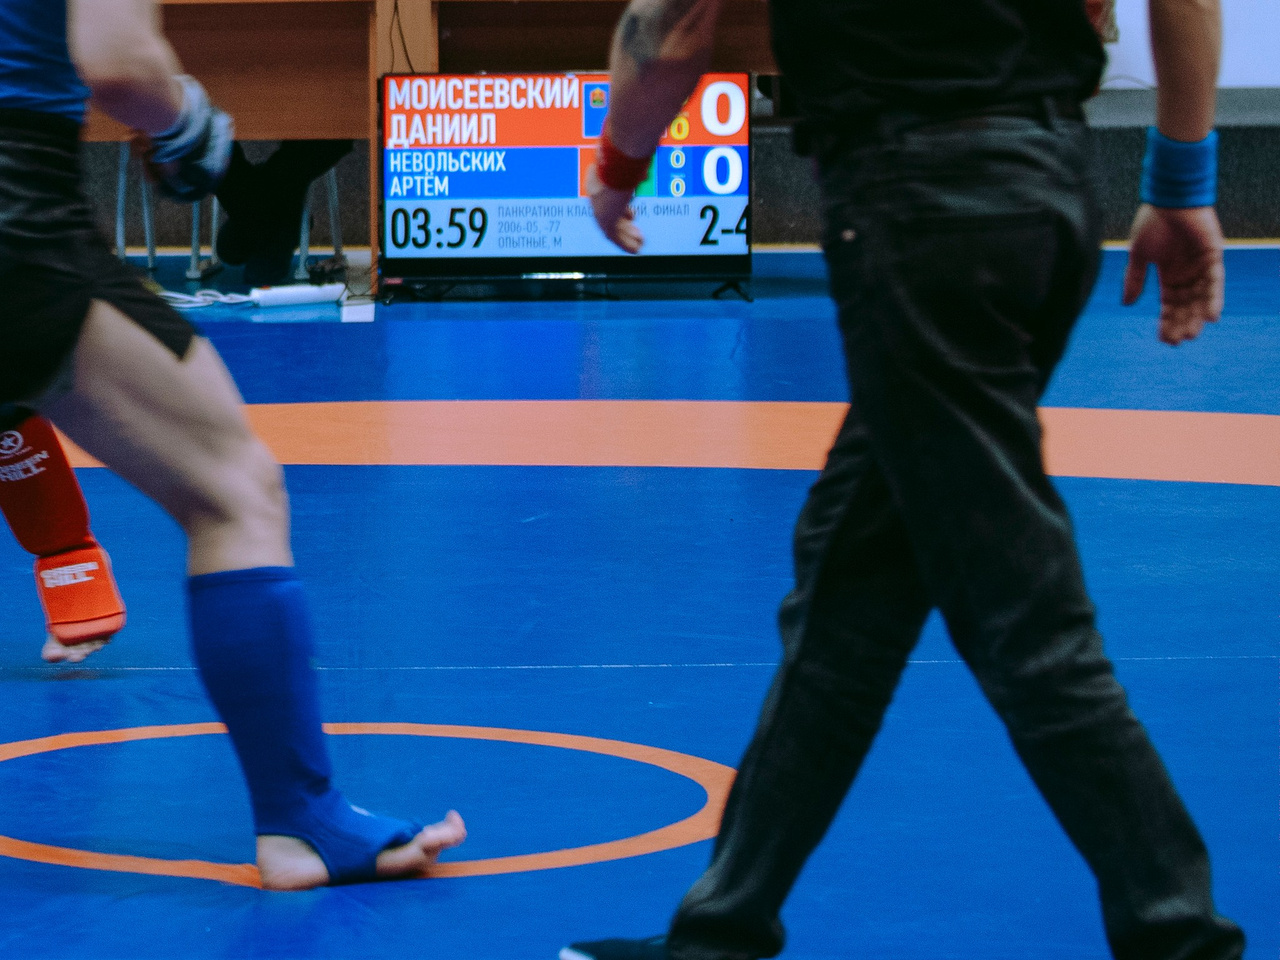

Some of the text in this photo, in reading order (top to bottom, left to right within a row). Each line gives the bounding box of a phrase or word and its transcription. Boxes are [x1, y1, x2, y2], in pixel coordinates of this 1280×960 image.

[389, 74, 579, 110] МОИСЕЕВСКИЙ
[388, 113, 496, 149] ДАНИИЛ
[390, 151, 506, 172] НЕВОЛЬСКИХ
[390, 171, 449, 196] АРТЁМ
[497, 205, 564, 218] ПАНКРАТИОН
[653, 203, 690, 217] ФИНАЛ
[391, 207, 488, 249] 03:59
[498, 236, 548, 250] ОПЫТНЫЕ,
